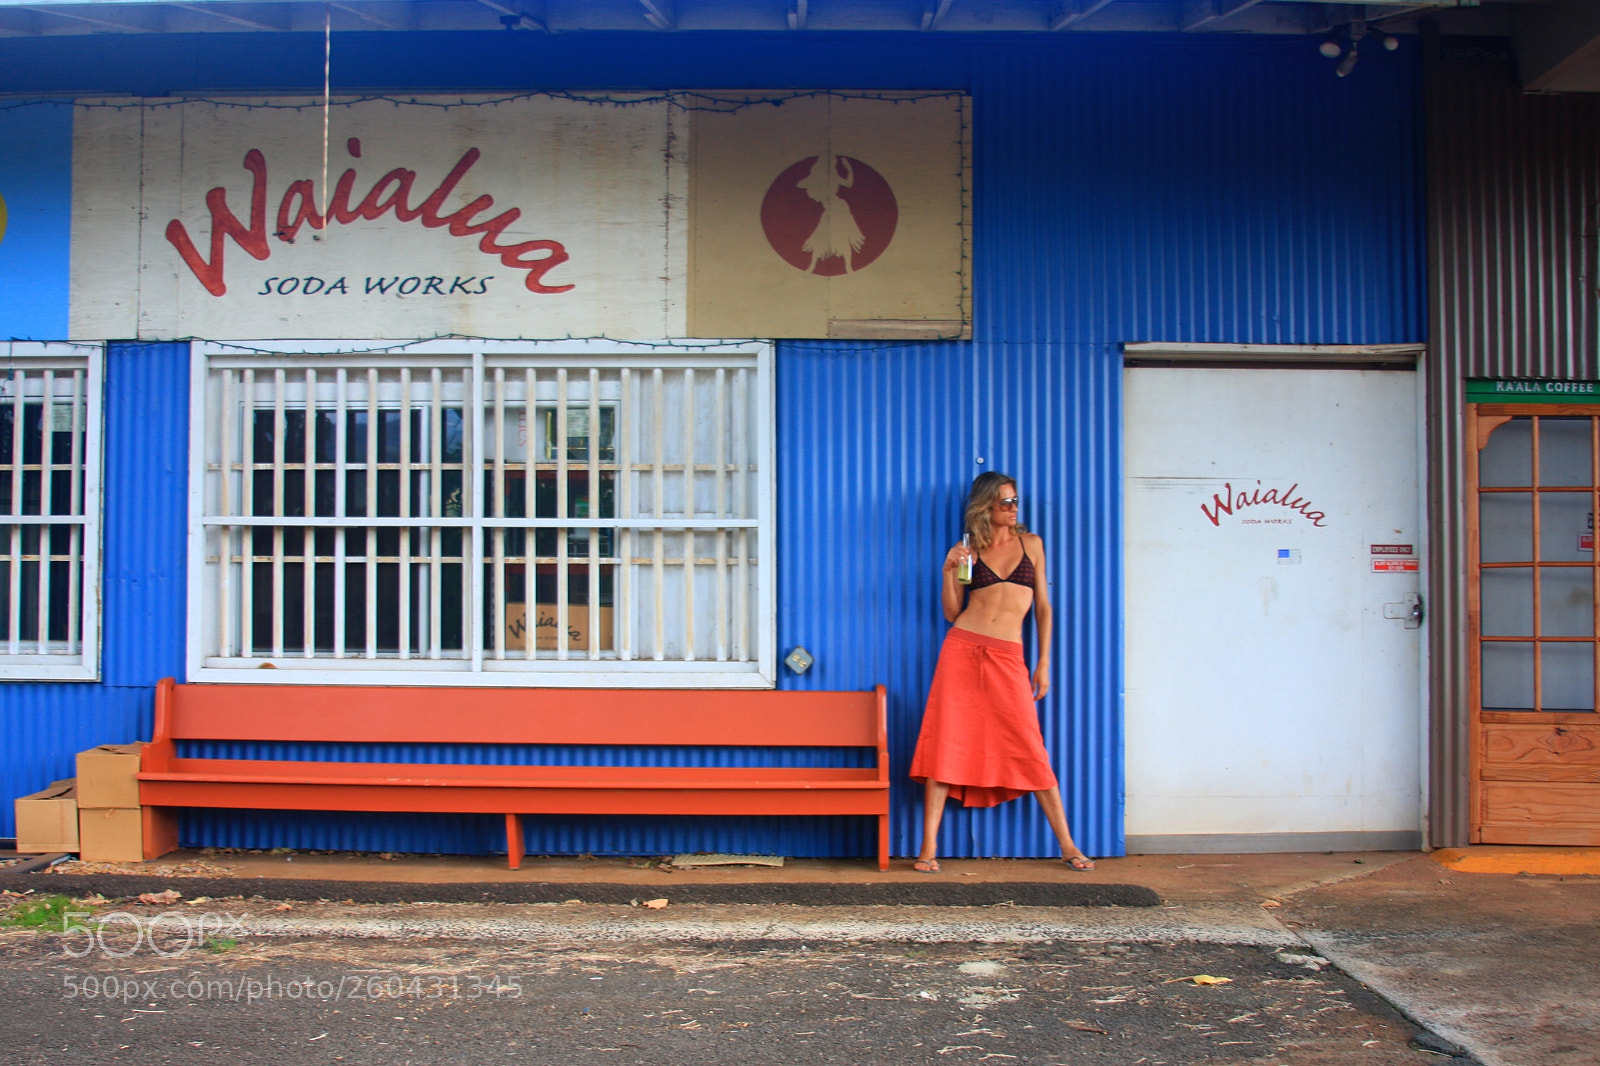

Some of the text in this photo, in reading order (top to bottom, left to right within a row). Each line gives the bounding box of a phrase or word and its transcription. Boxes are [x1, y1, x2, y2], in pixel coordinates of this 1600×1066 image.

[166, 137, 575, 297] Waialua
[258, 276, 495, 296] SODA WORKS
[1545, 382, 1594, 393] COFFEE
[1201, 480, 1328, 527] Waialua
